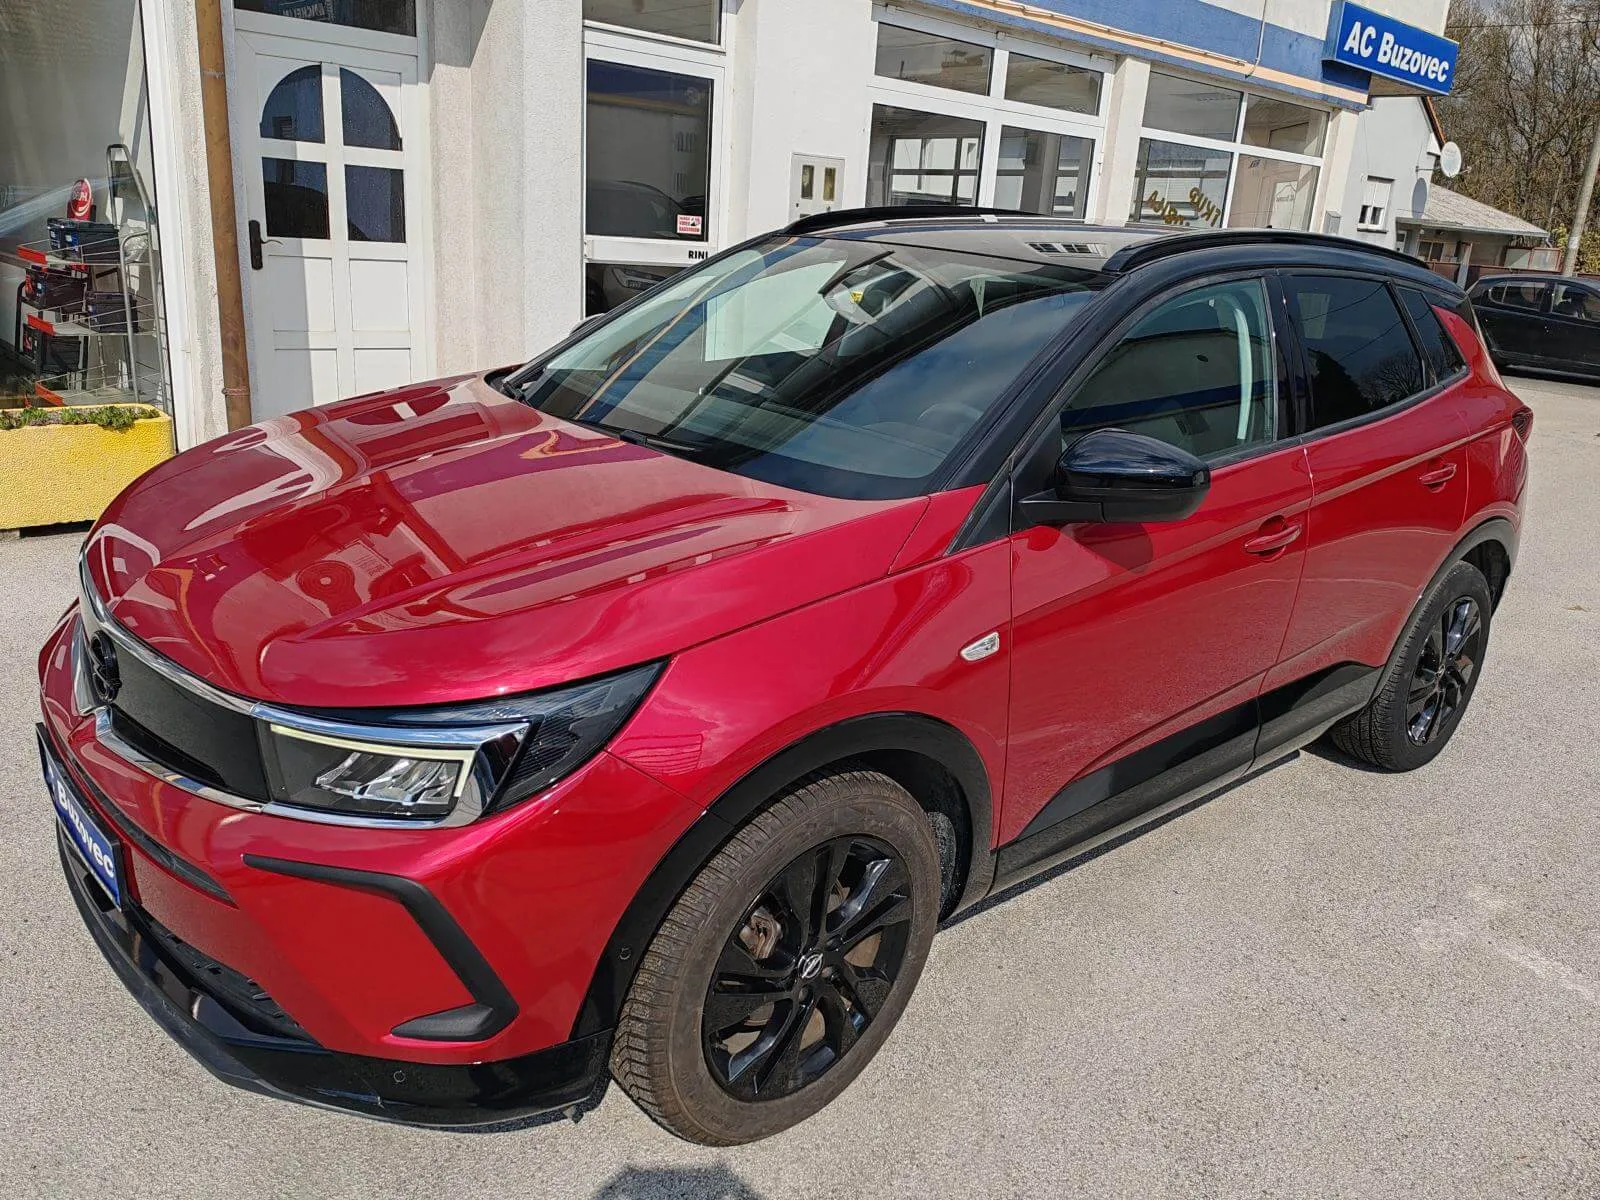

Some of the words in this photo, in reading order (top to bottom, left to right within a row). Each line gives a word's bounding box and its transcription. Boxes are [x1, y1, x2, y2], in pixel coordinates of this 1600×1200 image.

[1343, 21, 1376, 58] AC
[1377, 31, 1450, 83] Buzovec
[57, 780, 115, 878] Buzovec
